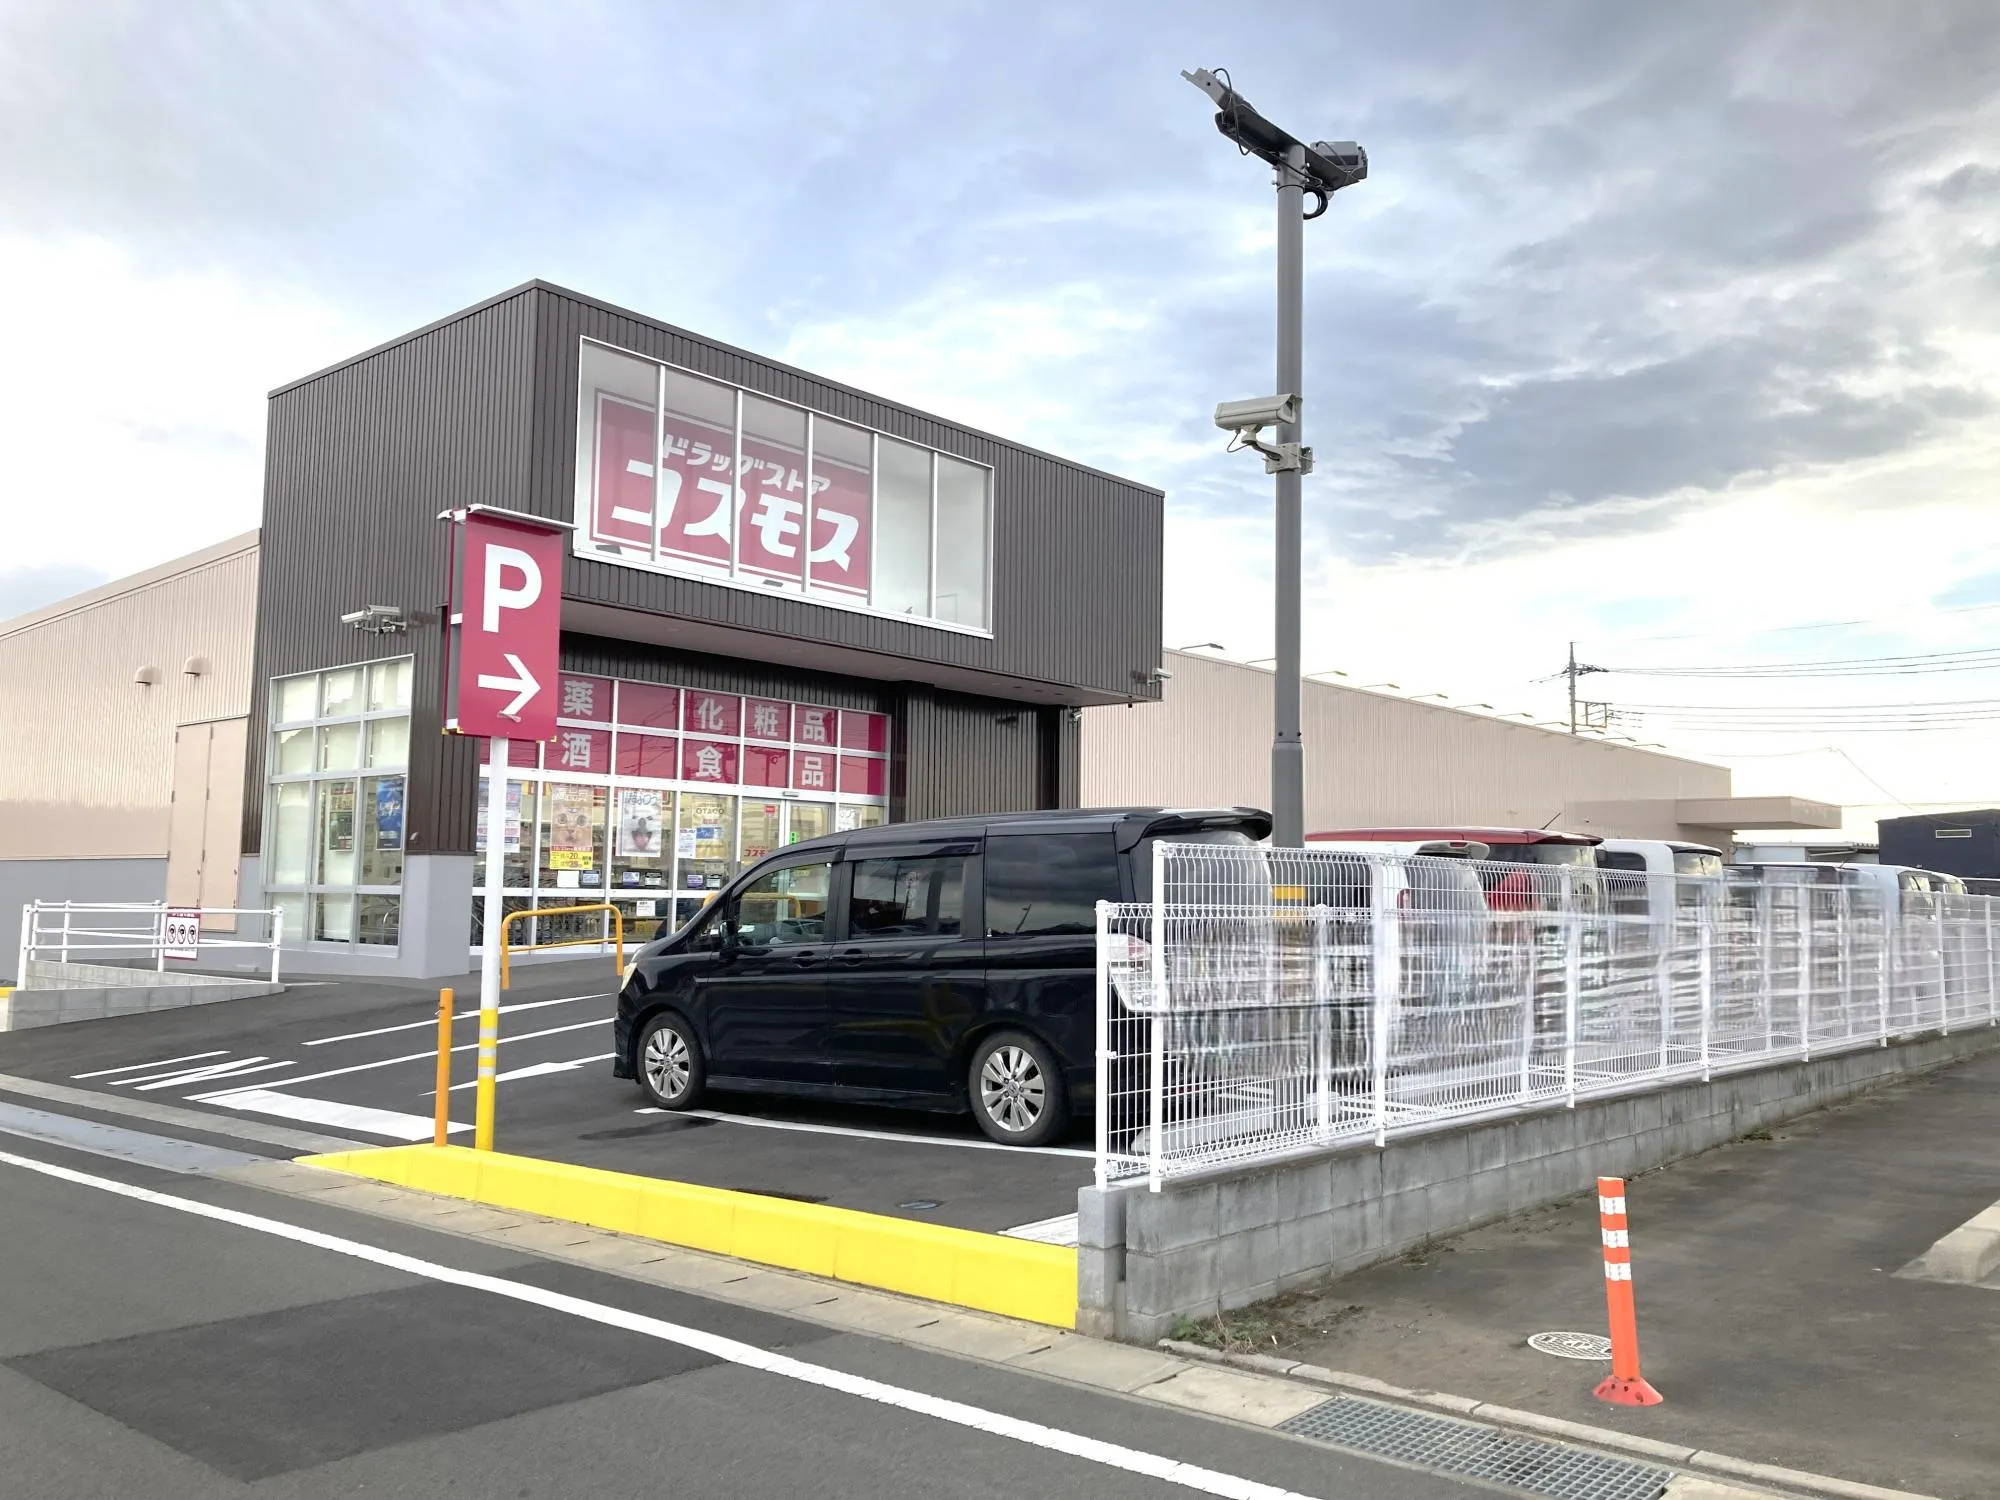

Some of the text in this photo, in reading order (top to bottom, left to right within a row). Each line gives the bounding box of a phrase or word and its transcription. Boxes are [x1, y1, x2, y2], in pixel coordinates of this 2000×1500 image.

[662, 434, 831, 496] ドラッグストア
[611, 459, 860, 573] コスモス
[483, 543, 543, 633] P
[563, 679, 826, 743] 薬 化粧品
[561, 731, 592, 769] 酒
